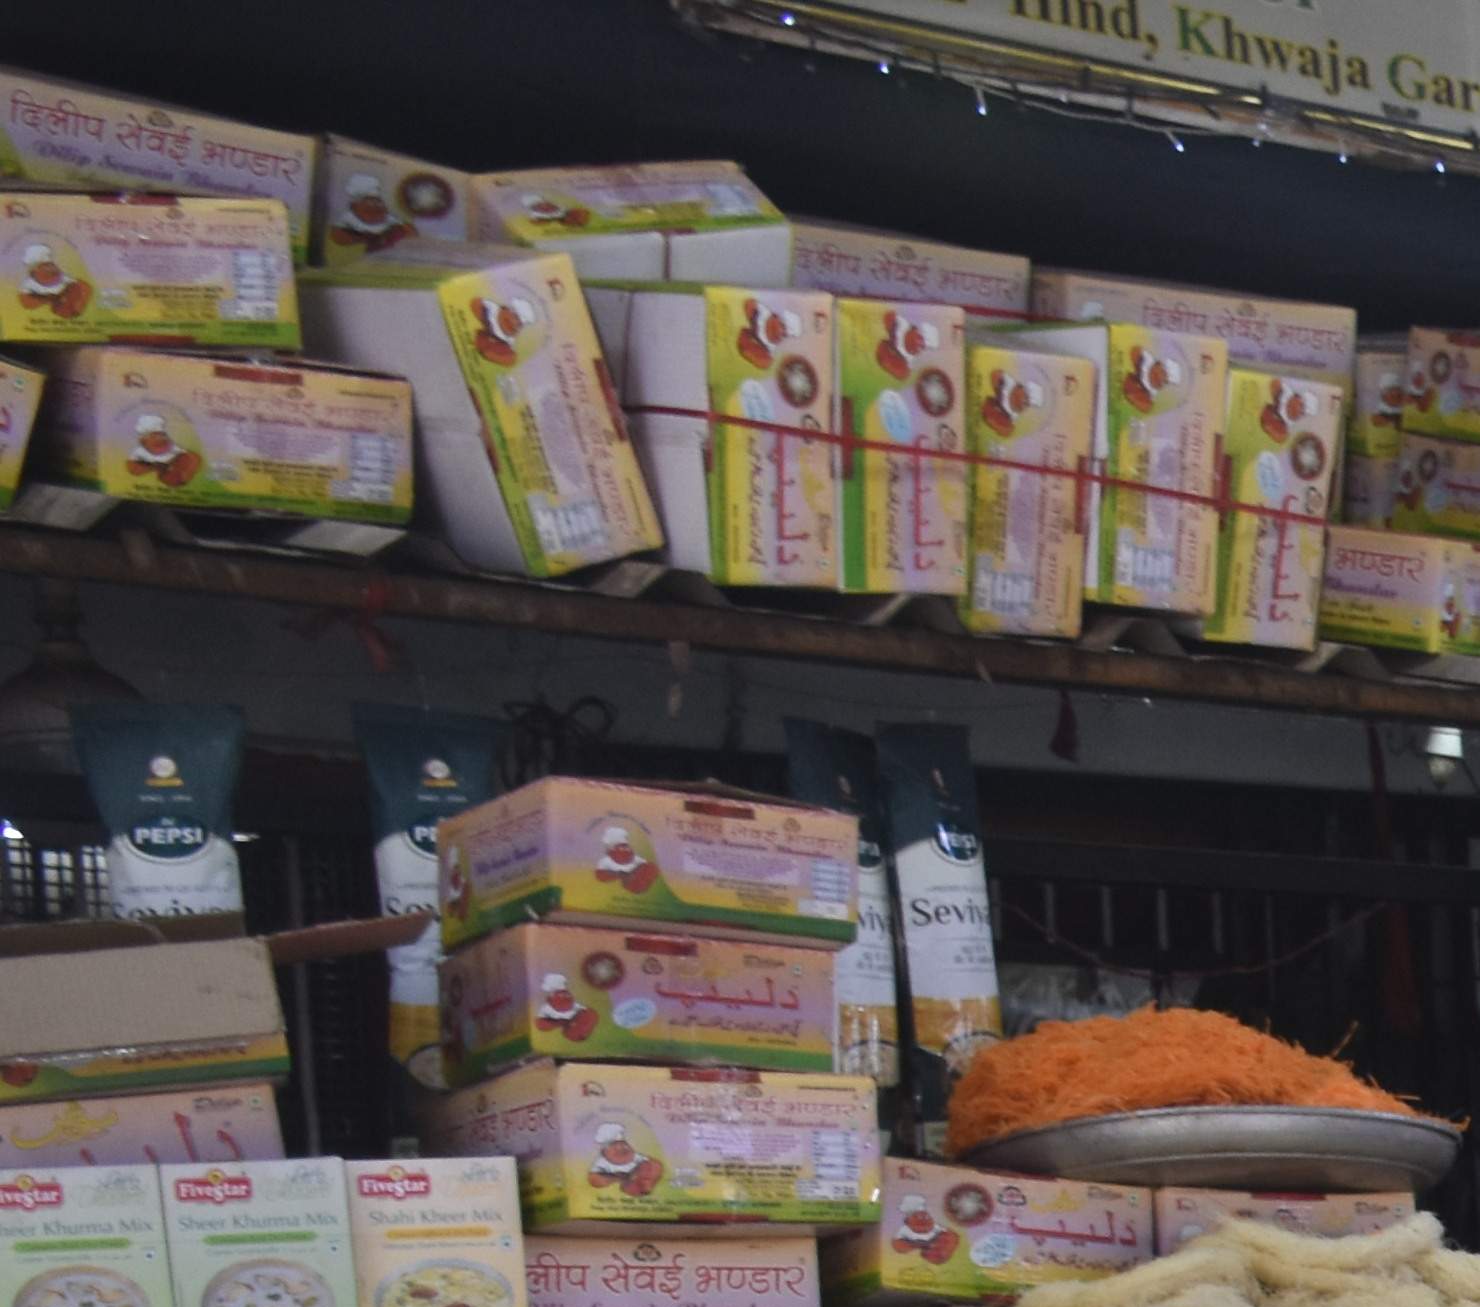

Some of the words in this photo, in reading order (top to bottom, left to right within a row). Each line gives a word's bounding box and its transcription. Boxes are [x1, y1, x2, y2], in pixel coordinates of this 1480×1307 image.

[1176, 5, 1370, 96] Khwaja
[1334, 546, 1428, 583] भण्डार
[133, 825, 205, 847] PEPSI
[910, 897, 992, 929] Seviy
[0, 1185, 61, 1210] iveStar
[0, 1218, 39, 1239] heer
[42, 1216, 111, 1238] Khurma
[113, 1214, 154, 1235] Mix
[177, 1215, 226, 1232] Sheer
[232, 1212, 301, 1230] Khurma
[304, 1210, 339, 1227] Mix
[367, 1209, 416, 1227] Shahi
[418, 1208, 468, 1226] Kheer
[470, 1208, 504, 1223] Mix
[525, 1250, 590, 1294] लीप
[600, 1250, 688, 1301] सेवई
[695, 1264, 808, 1299] भण्डार
